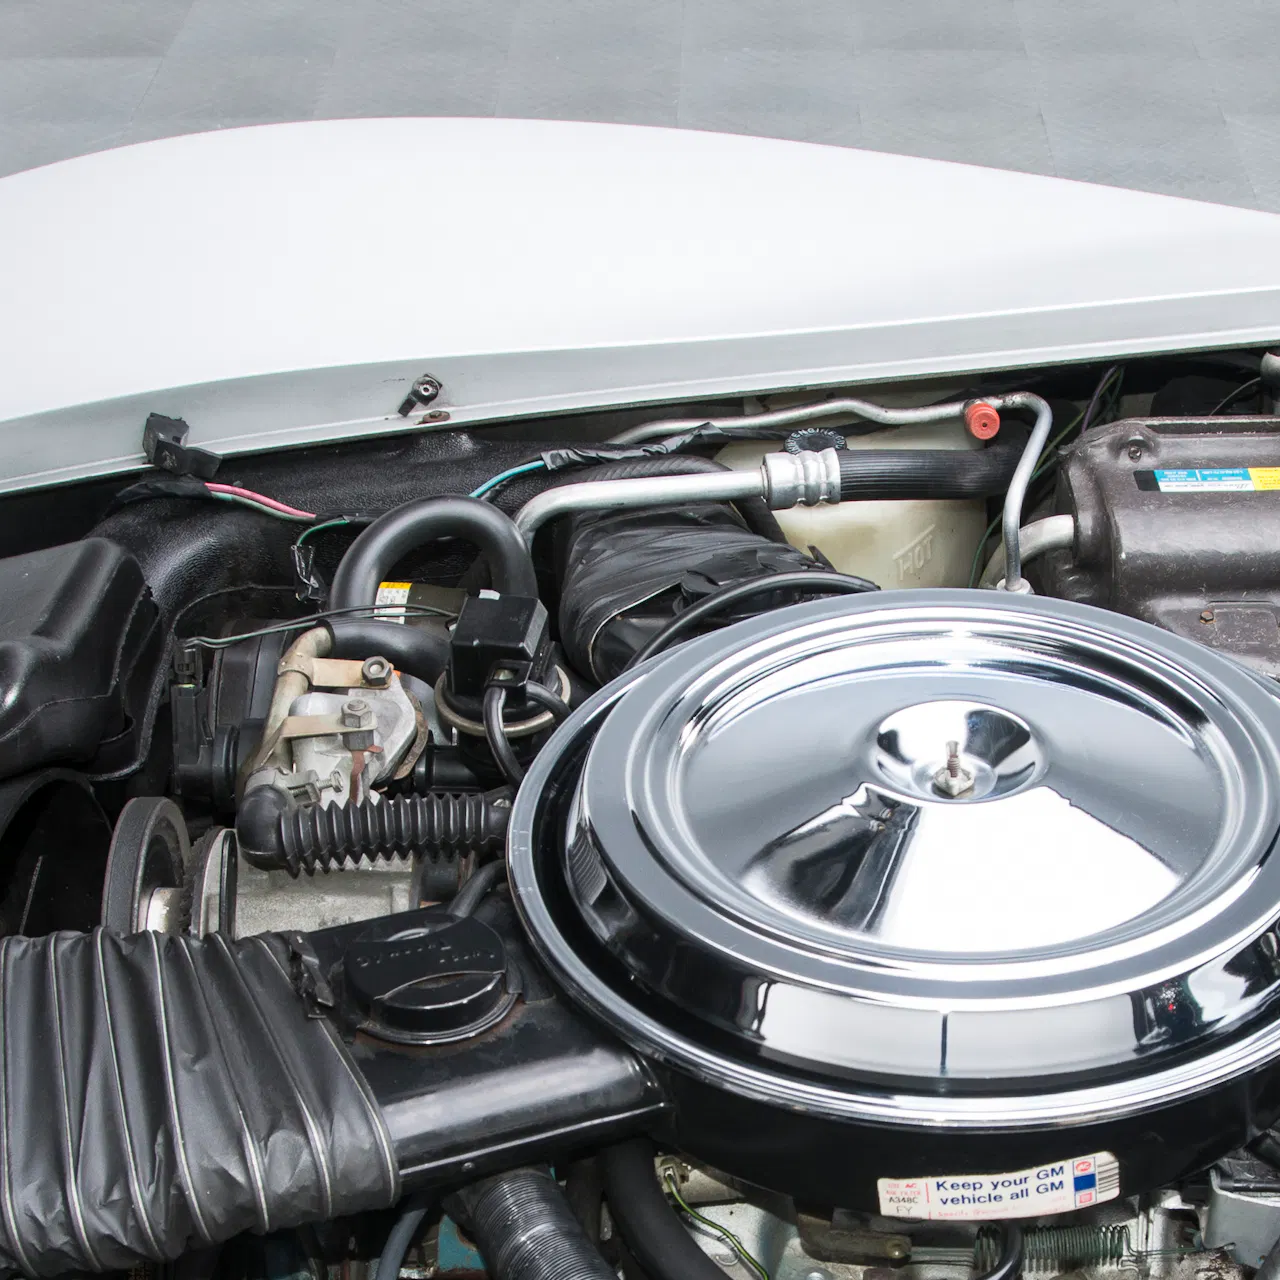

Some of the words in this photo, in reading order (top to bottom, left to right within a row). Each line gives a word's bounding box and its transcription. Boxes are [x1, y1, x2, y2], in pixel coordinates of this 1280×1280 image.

[936, 1180, 983, 1192] Keep
[991, 1176, 1029, 1192] your
[1036, 1165, 1064, 1180] GM
[940, 1192, 1003, 1205] vehicle
[1010, 1188, 1029, 1201] all
[1036, 1180, 1064, 1194] GM
